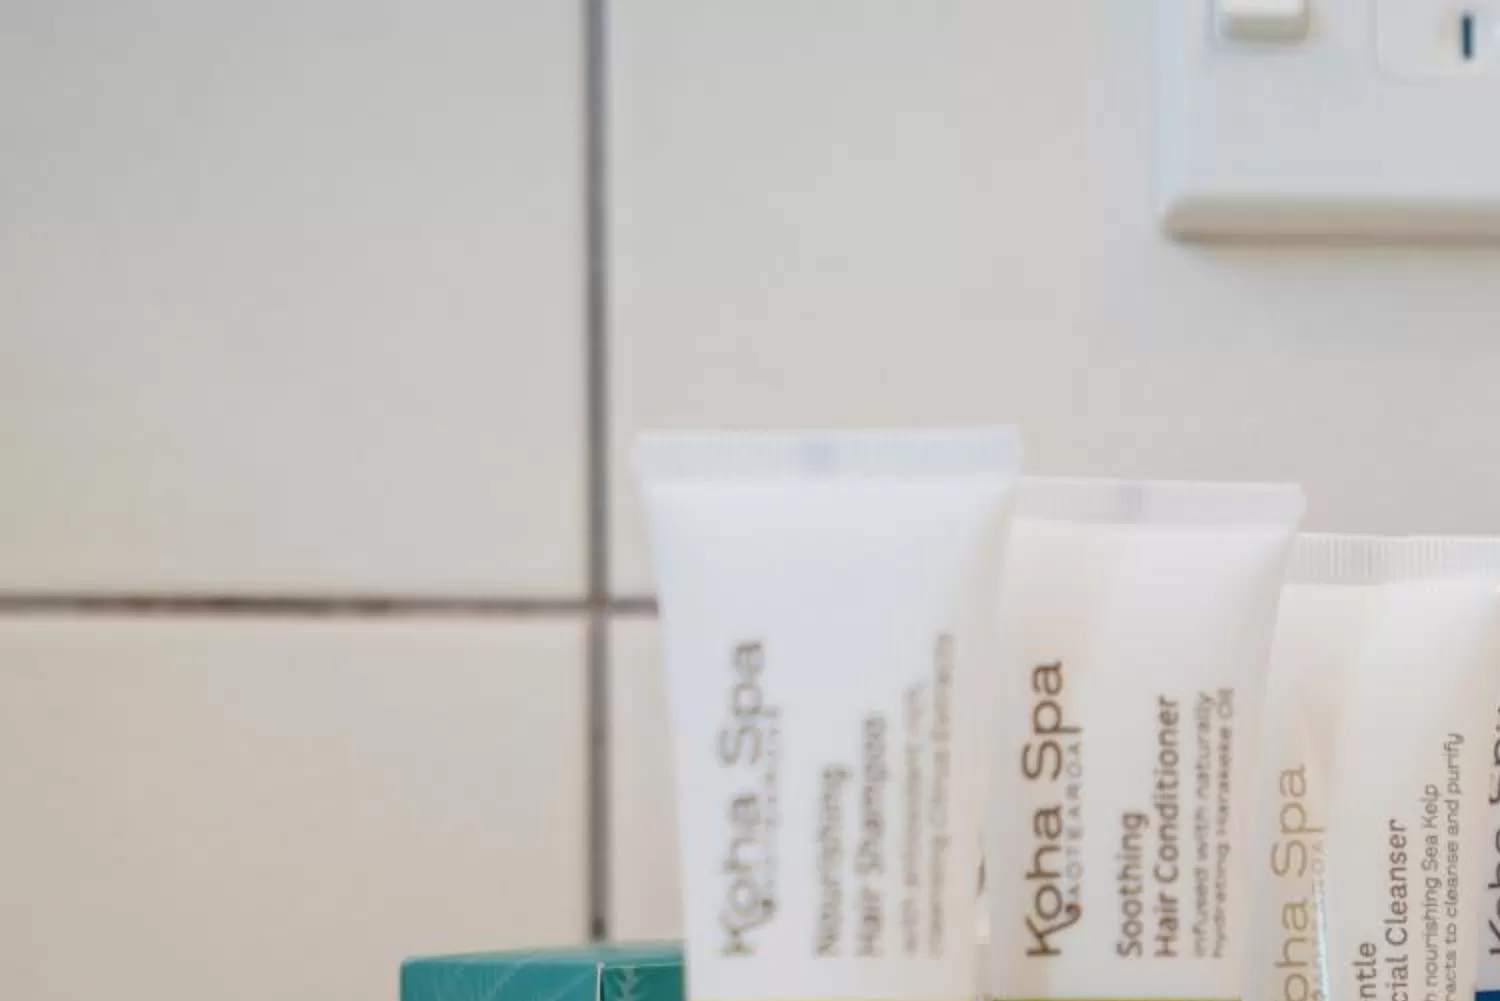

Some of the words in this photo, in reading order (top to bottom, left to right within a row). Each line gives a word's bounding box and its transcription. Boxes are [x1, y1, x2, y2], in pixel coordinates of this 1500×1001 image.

[717, 640, 778, 767] Spa
[1021, 661, 1083, 781] Spa
[1153, 694, 1179, 884] Conditioner
[1419, 783, 1441, 828] Kelp
[1444, 732, 1465, 793] purify
[1444, 800, 1460, 836] and
[717, 795, 777, 956] Koha
[1270, 764, 1326, 877] Spa
[1421, 836, 1439, 871] Sea
[1024, 805, 1082, 957] Koha
[1116, 811, 1149, 957] Soothing
[1154, 892, 1179, 957] Hair
[1383, 819, 1409, 946] Cleanser
[1421, 875, 1442, 987] nourishing
[1444, 924, 1457, 945] to
[1445, 841, 1459, 917] cleanse
